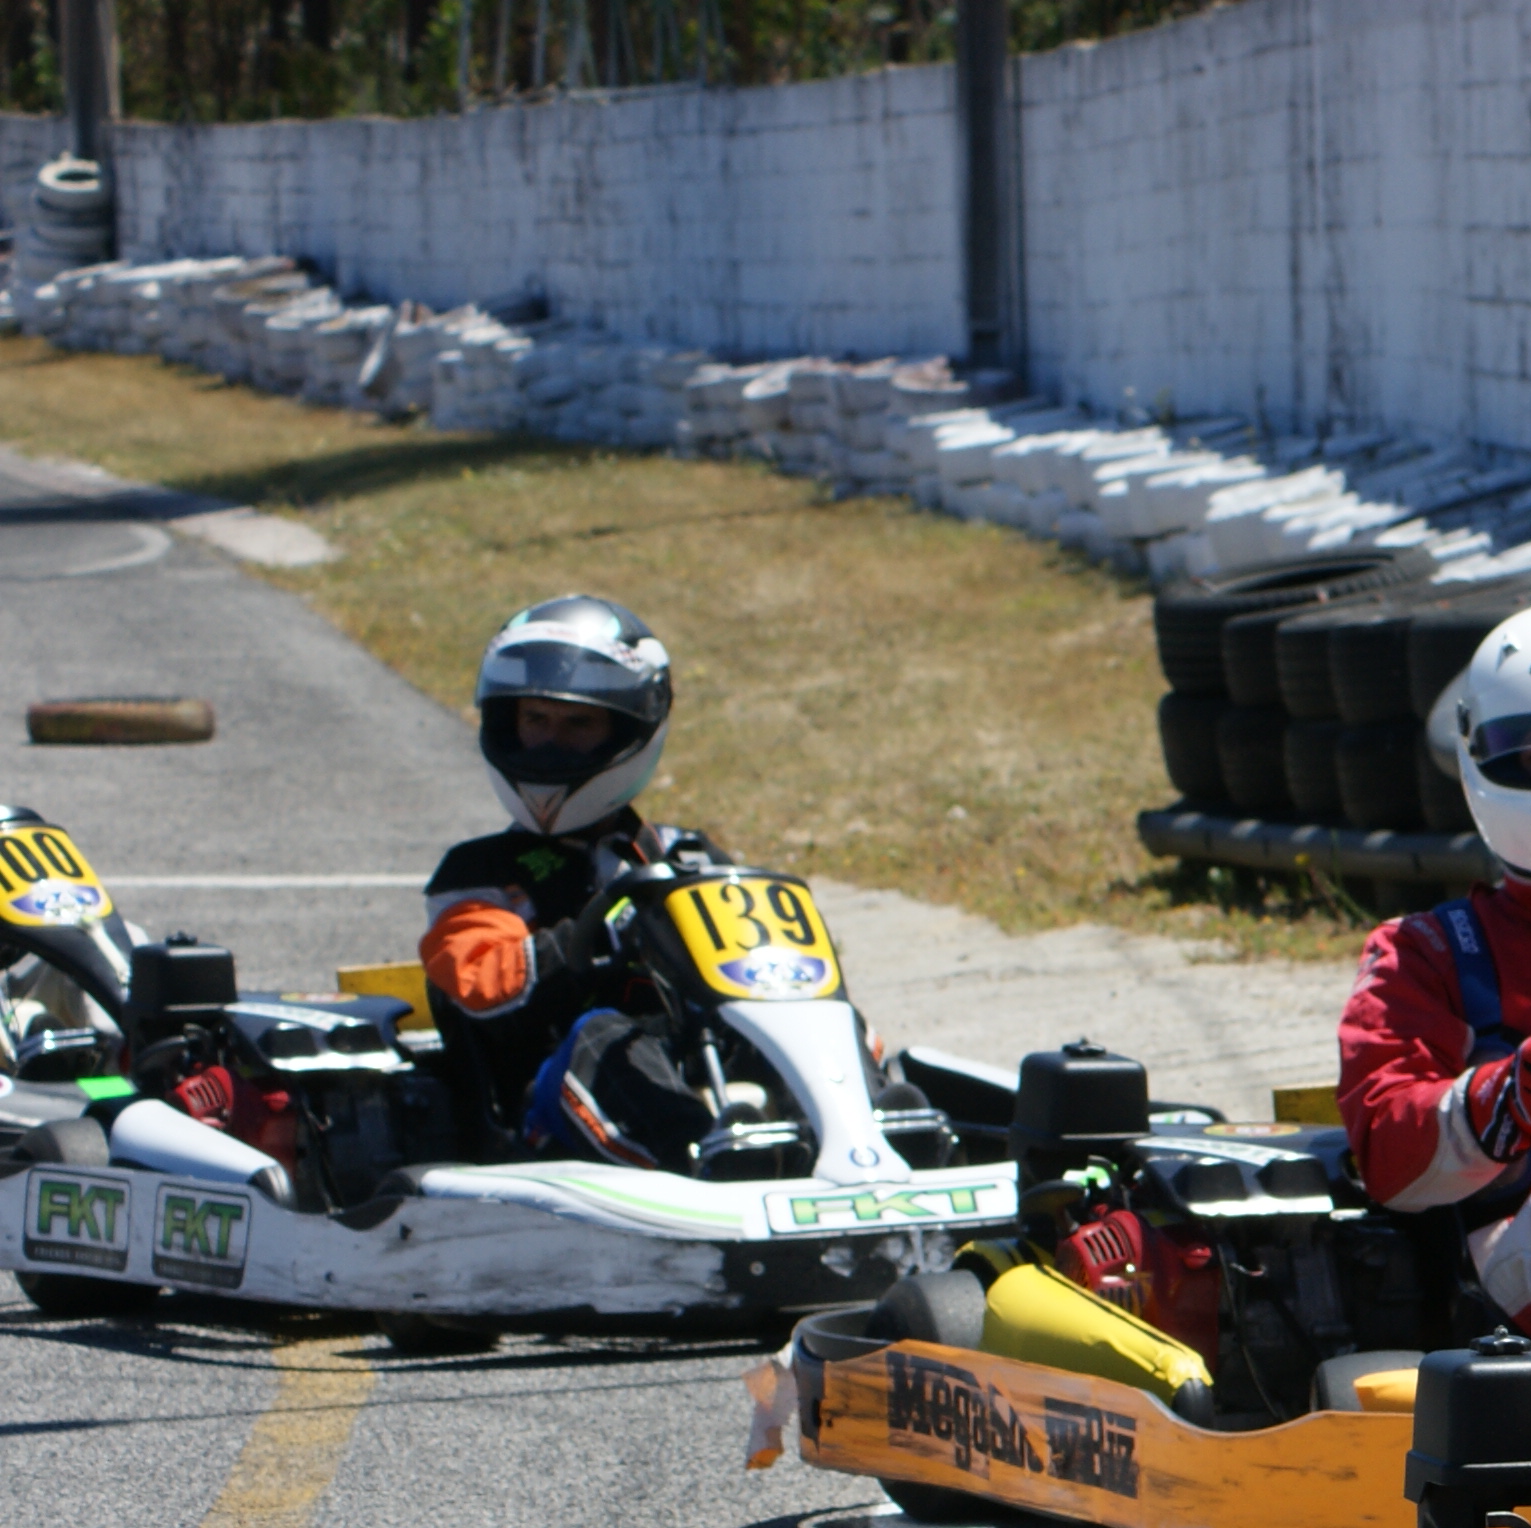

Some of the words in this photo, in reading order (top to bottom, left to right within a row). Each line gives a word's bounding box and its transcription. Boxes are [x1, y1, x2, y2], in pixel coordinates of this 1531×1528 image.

[689, 884, 816, 953] 139
[37, 1180, 125, 1244] FKT
[161, 1194, 244, 1260] FKT
[790, 1184, 998, 1225] FKT
